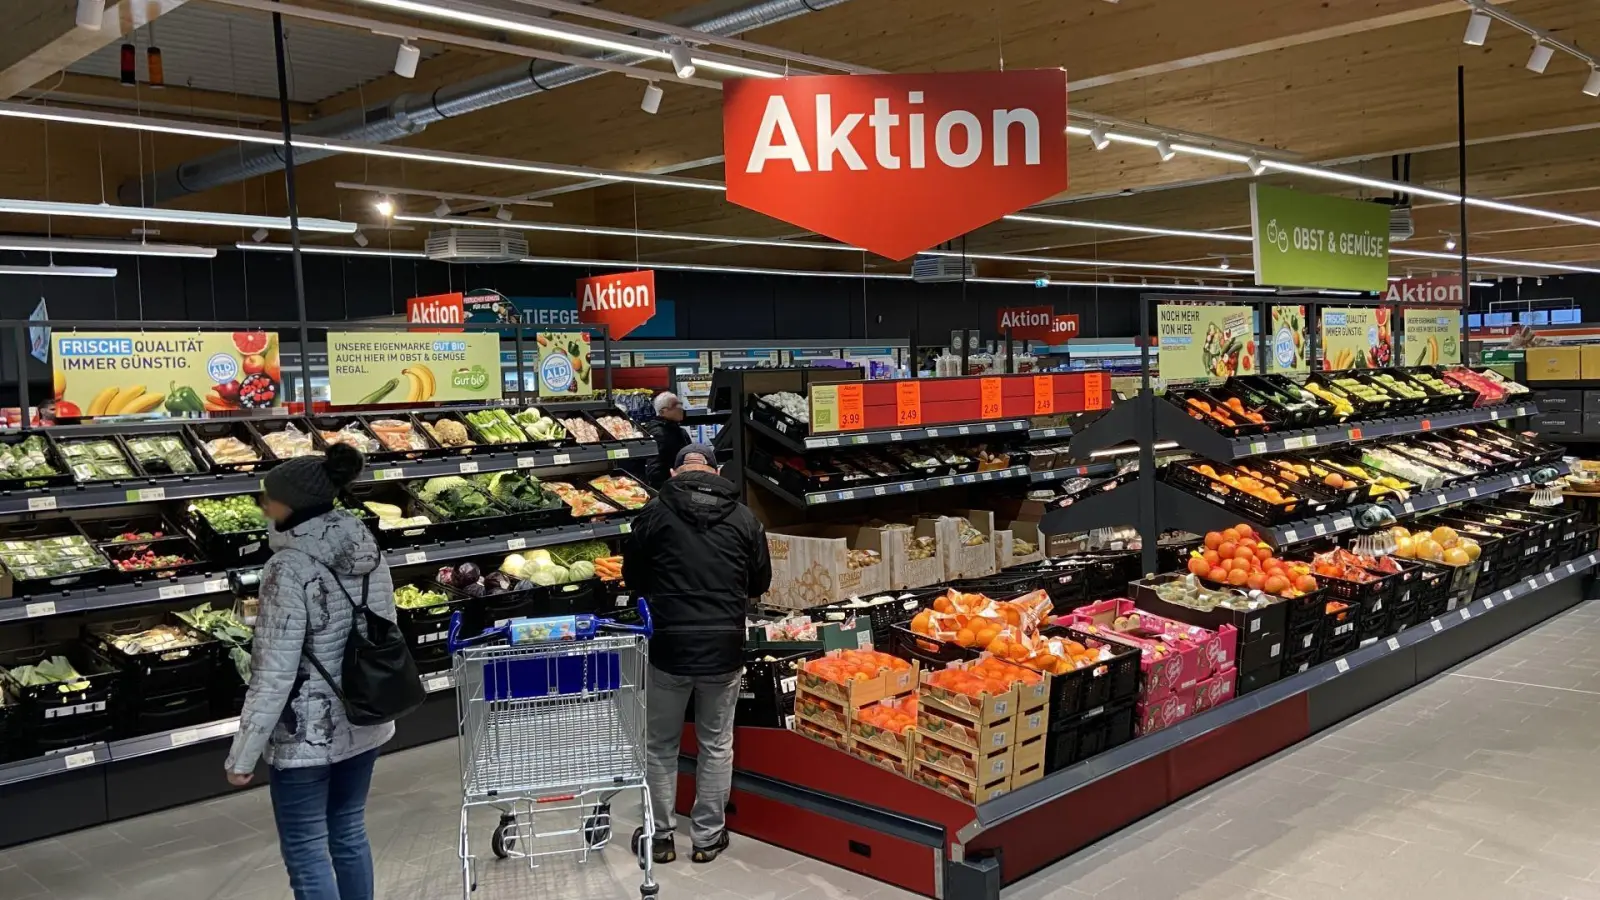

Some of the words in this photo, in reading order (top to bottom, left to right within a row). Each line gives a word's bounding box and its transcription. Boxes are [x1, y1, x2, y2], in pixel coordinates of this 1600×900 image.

[746, 91, 1040, 173] Aktion
[1293, 227, 1324, 251] OBST
[1328, 231, 1336, 253] &
[1340, 231, 1384, 258] GEMÜSE
[582, 281, 649, 312] Aktion
[1386, 281, 1462, 302] Aktion
[411, 303, 459, 324] Aktion
[523, 308, 583, 324] TIEFGE
[1001, 310, 1049, 328] Aktion
[1161, 310, 1179, 321] NOCH
[1181, 310, 1200, 321] MEHR
[1161, 323, 1176, 334] VON
[62, 340, 130, 353] FRISCHE
[135, 338, 204, 352] QUALITÄT
[335, 342, 372, 350] UNSERE
[374, 342, 430, 351] EIGENMARKE
[434, 342, 450, 350] GUT
[452, 342, 465, 350] BIO
[63, 358, 116, 370] IMMER
[121, 354, 191, 369] GÜNSTIG.
[336, 354, 362, 363] AUCH
[364, 354, 385, 362] HIER
[388, 353, 398, 361] IM
[400, 353, 422, 362] OBST
[432, 351, 465, 360] GEMÜSE
[336, 365, 369, 374] REGAL.
[547, 364, 570, 380] ALDI
[985, 404, 998, 414] 2.49
[1037, 400, 1050, 410] 2.49
[842, 414, 859, 425] 3.99
[901, 410, 917, 421] 2.49
